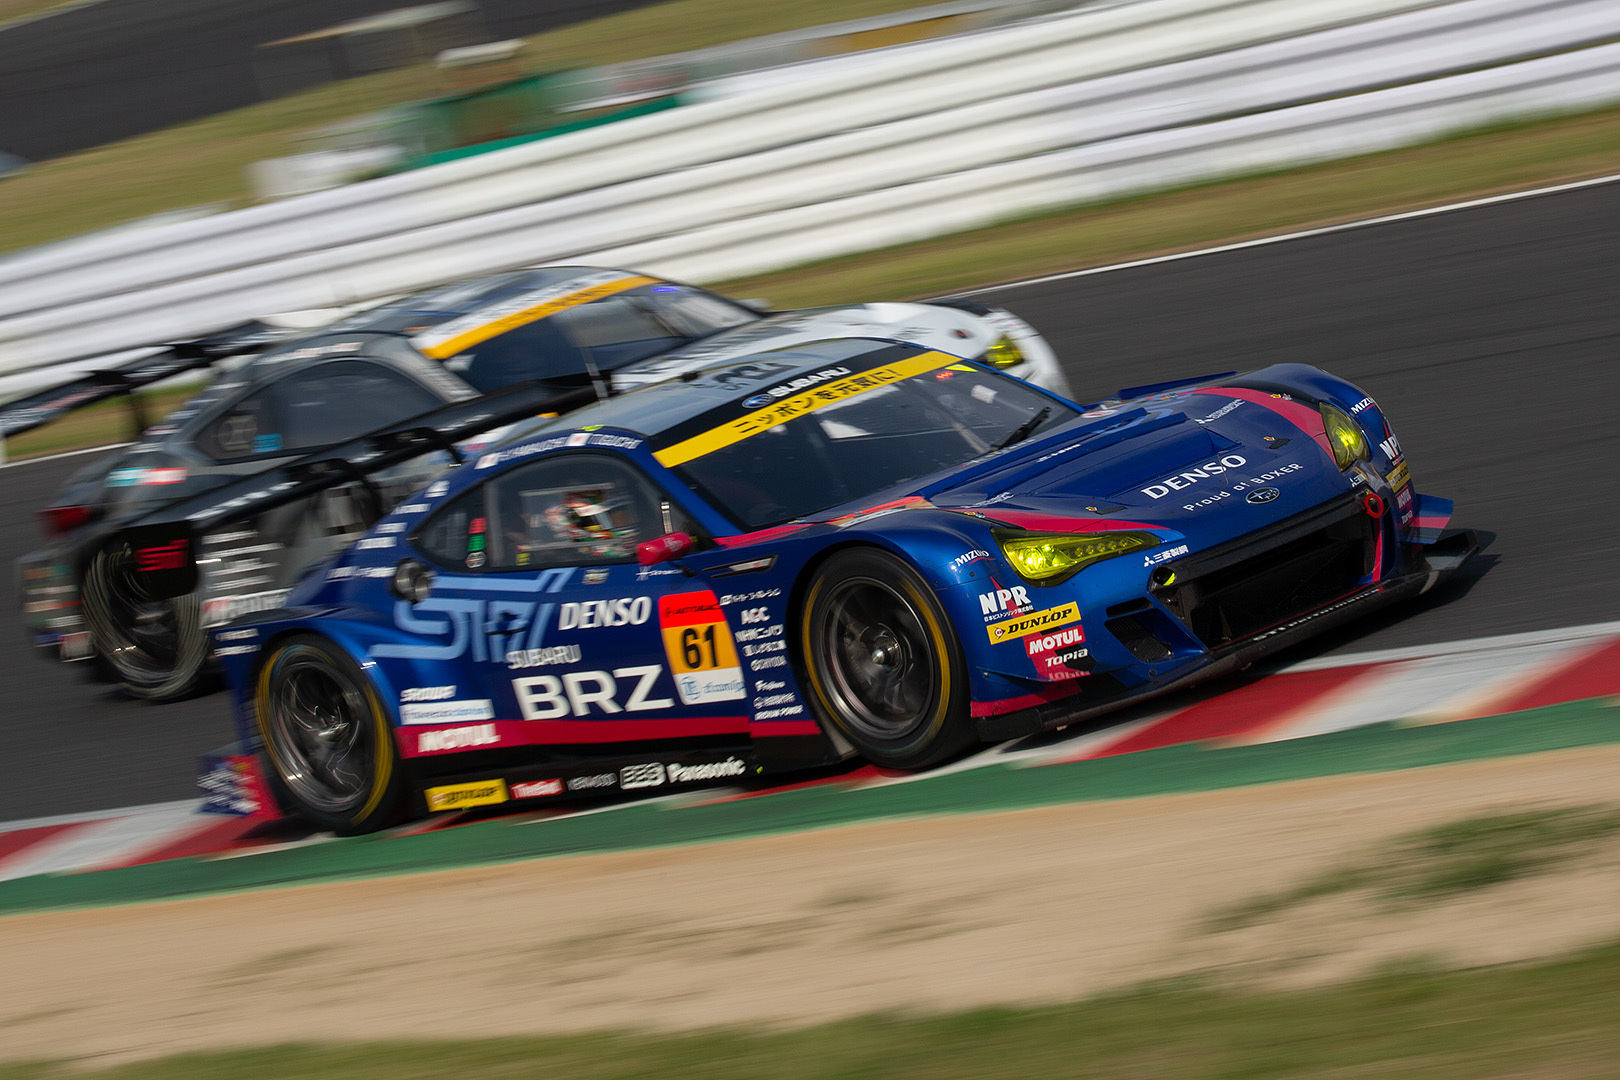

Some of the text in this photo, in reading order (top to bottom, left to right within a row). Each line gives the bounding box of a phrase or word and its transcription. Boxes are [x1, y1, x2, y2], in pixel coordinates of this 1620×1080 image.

[768, 366, 852, 398] SUBARU
[1141, 453, 1248, 500] DENSO
[1183, 490, 1231, 512] Proud
[1250, 462, 1304, 486] BOXER
[558, 596, 653, 631] DENSO
[978, 585, 1031, 615] NPR
[1007, 608, 1073, 635] DUNLOP
[505, 644, 582, 670] SUBARU
[682, 624, 720, 669] 61
[1029, 628, 1083, 655] MOTUL
[512, 663, 676, 721] BRZ
[666, 756, 747, 783] Panasonic
